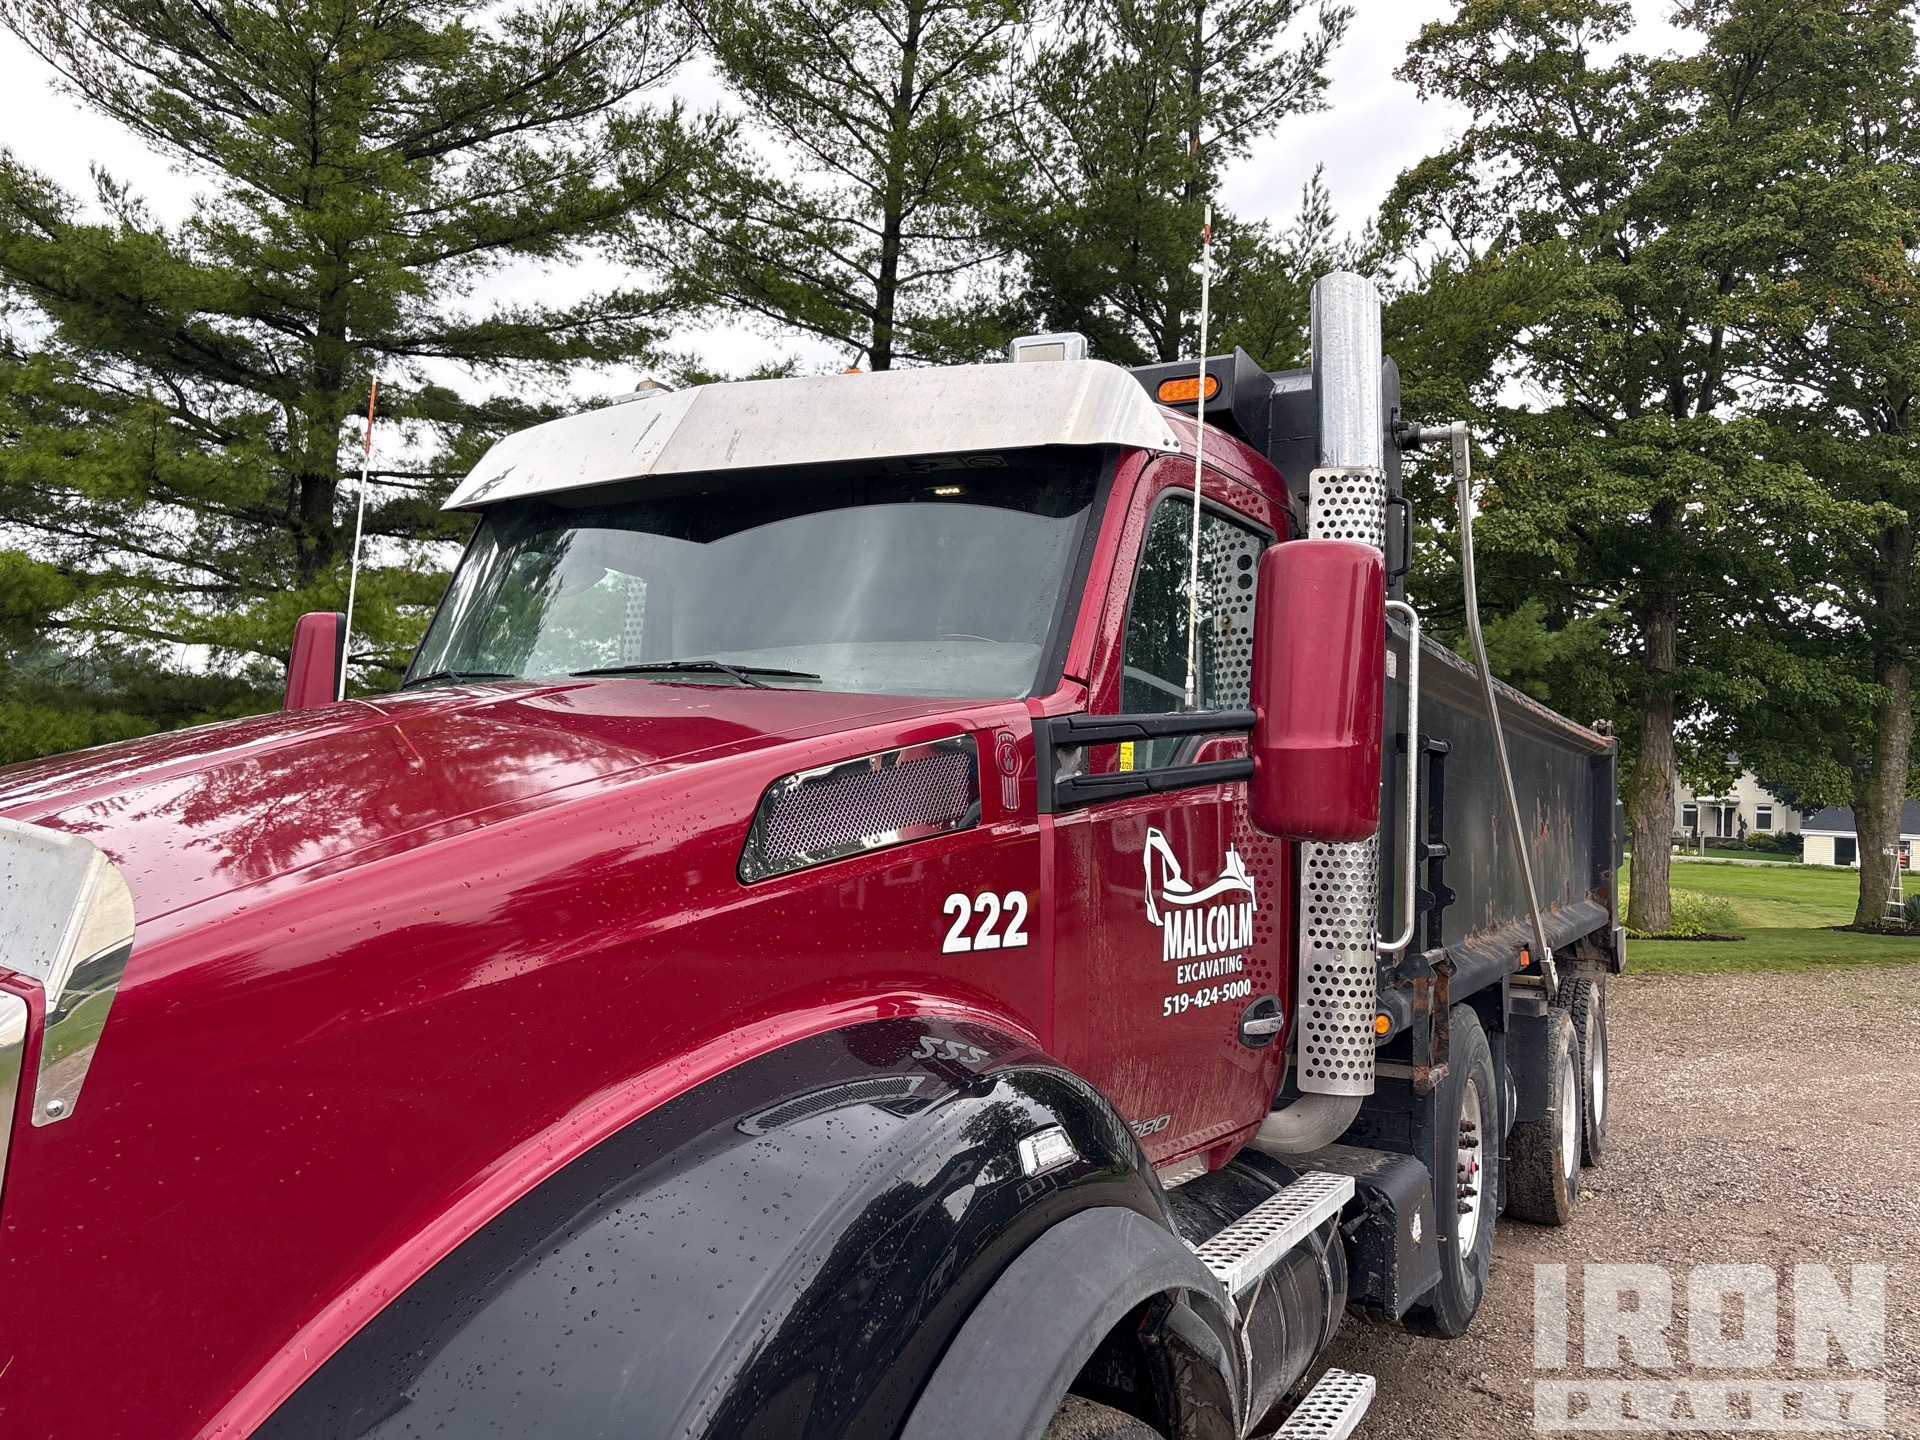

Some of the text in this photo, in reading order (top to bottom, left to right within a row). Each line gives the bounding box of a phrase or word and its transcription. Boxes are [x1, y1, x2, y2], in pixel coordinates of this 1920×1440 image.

[942, 890, 1028, 953] 222
[1163, 902, 1253, 962] MALCOLM
[1177, 954, 1243, 985] EXCAVATING
[1163, 978, 1252, 1017] 519-424-5000
